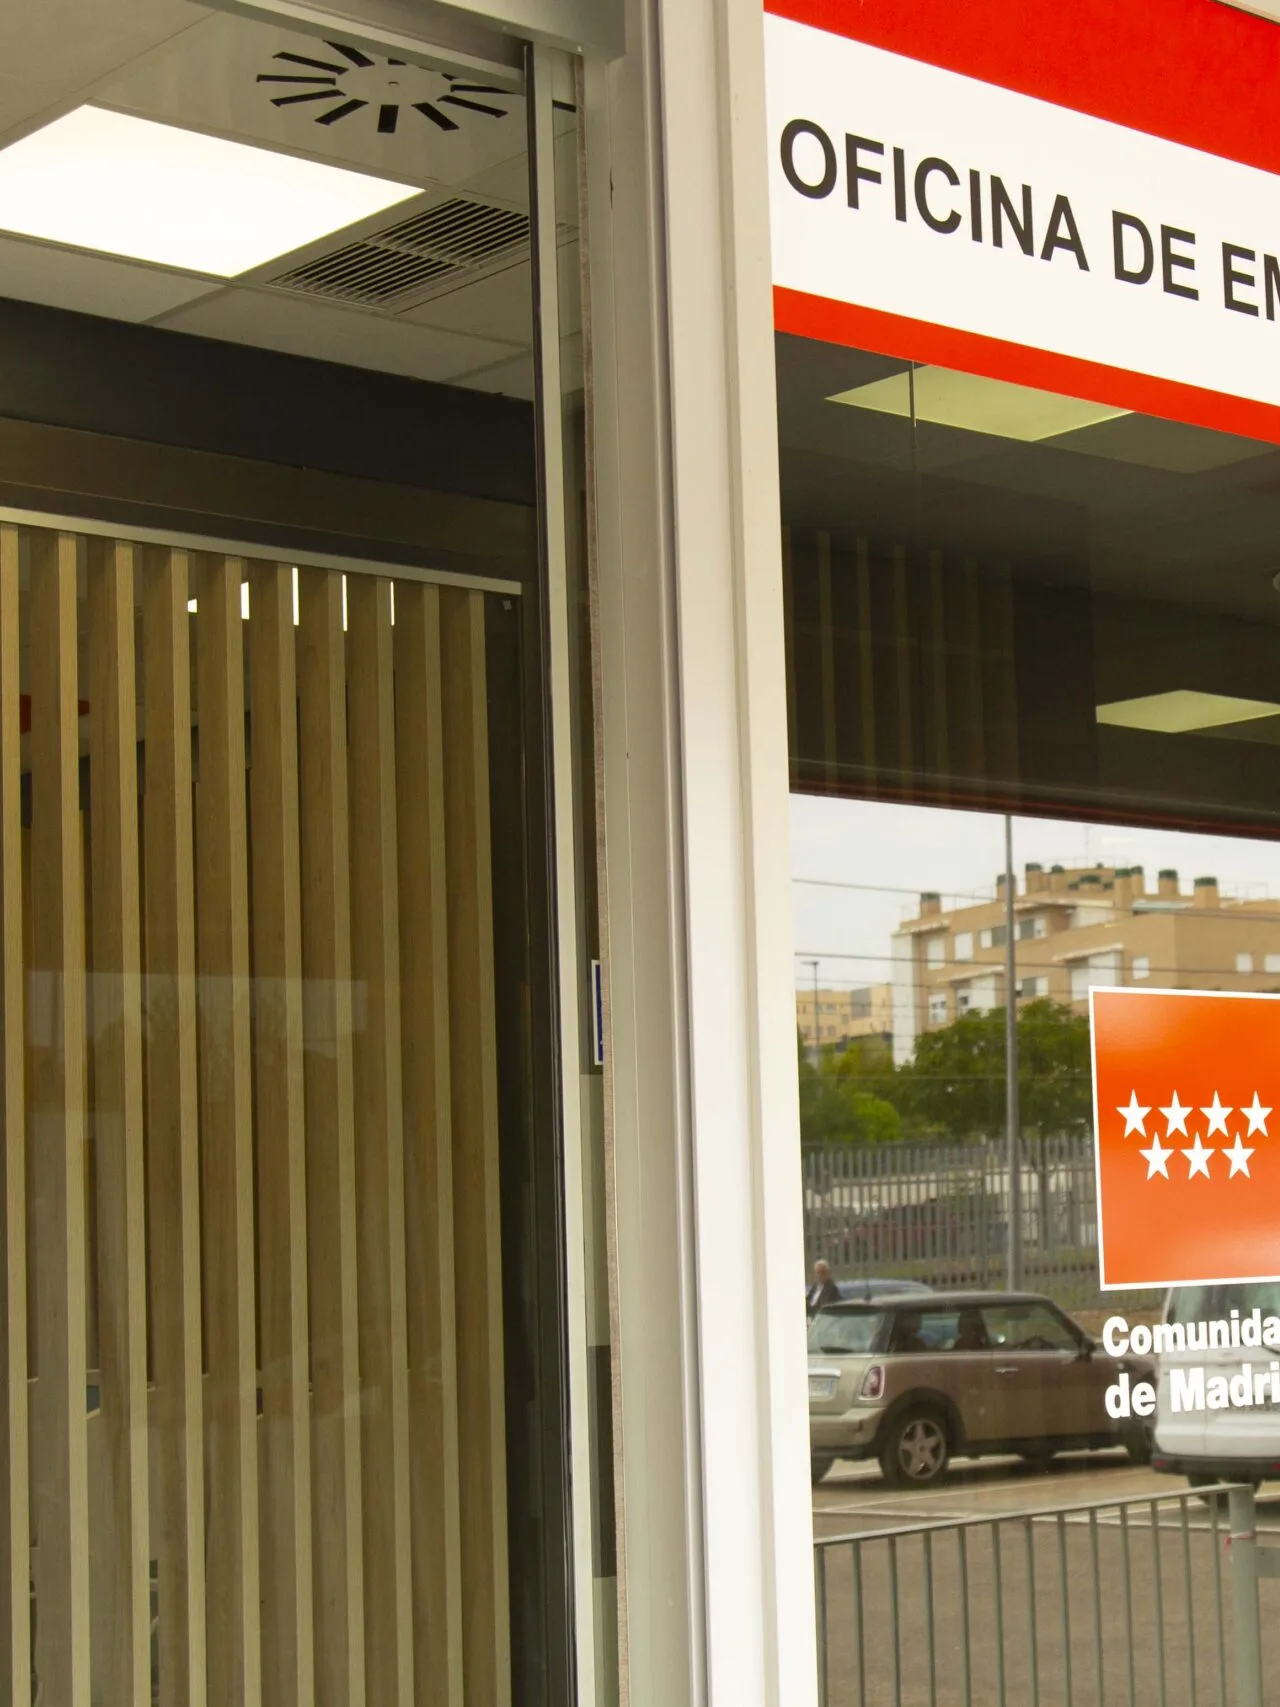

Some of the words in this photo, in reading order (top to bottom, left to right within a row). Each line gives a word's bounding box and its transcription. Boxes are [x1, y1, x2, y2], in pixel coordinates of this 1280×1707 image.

[780, 118, 1090, 272] OFICINA
[1111, 210, 1199, 301] DE
[1105, 1373, 1156, 1419] de
